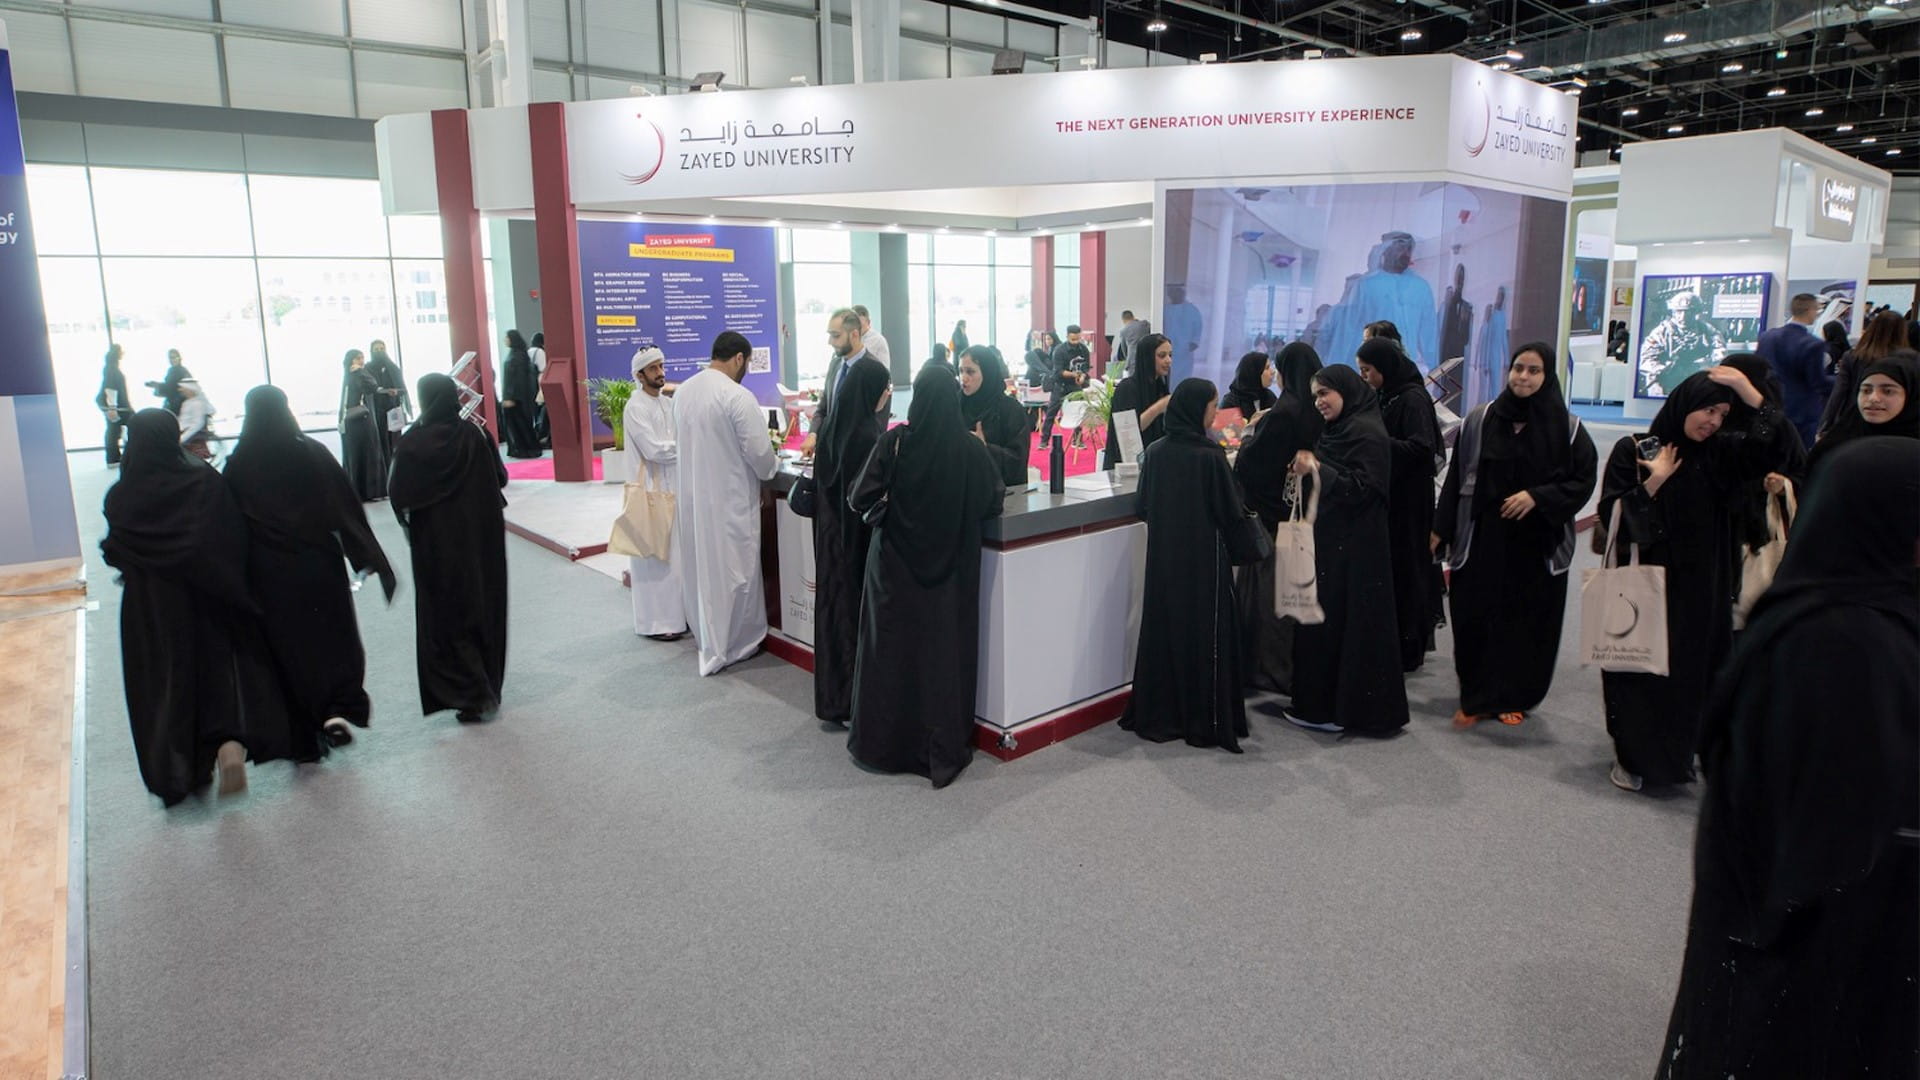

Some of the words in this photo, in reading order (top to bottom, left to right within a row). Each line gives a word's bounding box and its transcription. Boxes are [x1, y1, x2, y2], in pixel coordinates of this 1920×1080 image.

[743, 116, 855, 139] جامعة
[1056, 121, 1083, 133] THE
[1087, 118, 1125, 131] NEXT
[1129, 114, 1223, 130] GENERATION
[1228, 110, 1316, 126] UNIVERSITY
[1321, 107, 1416, 123] EXPERIENCE
[680, 120, 737, 146] زايد
[680, 151, 736, 171] ZAYED
[744, 145, 855, 168] UNIVERSITY
[1494, 131, 1521, 153] ZAYED
[1522, 138, 1567, 163] UNIVERSITY
[0, 212, 15, 226] of
[674, 237, 711, 245] UNIVERSITY
[634, 247, 693, 257] UNDERGRADUATE
[694, 251, 731, 260] PROGRAMS
